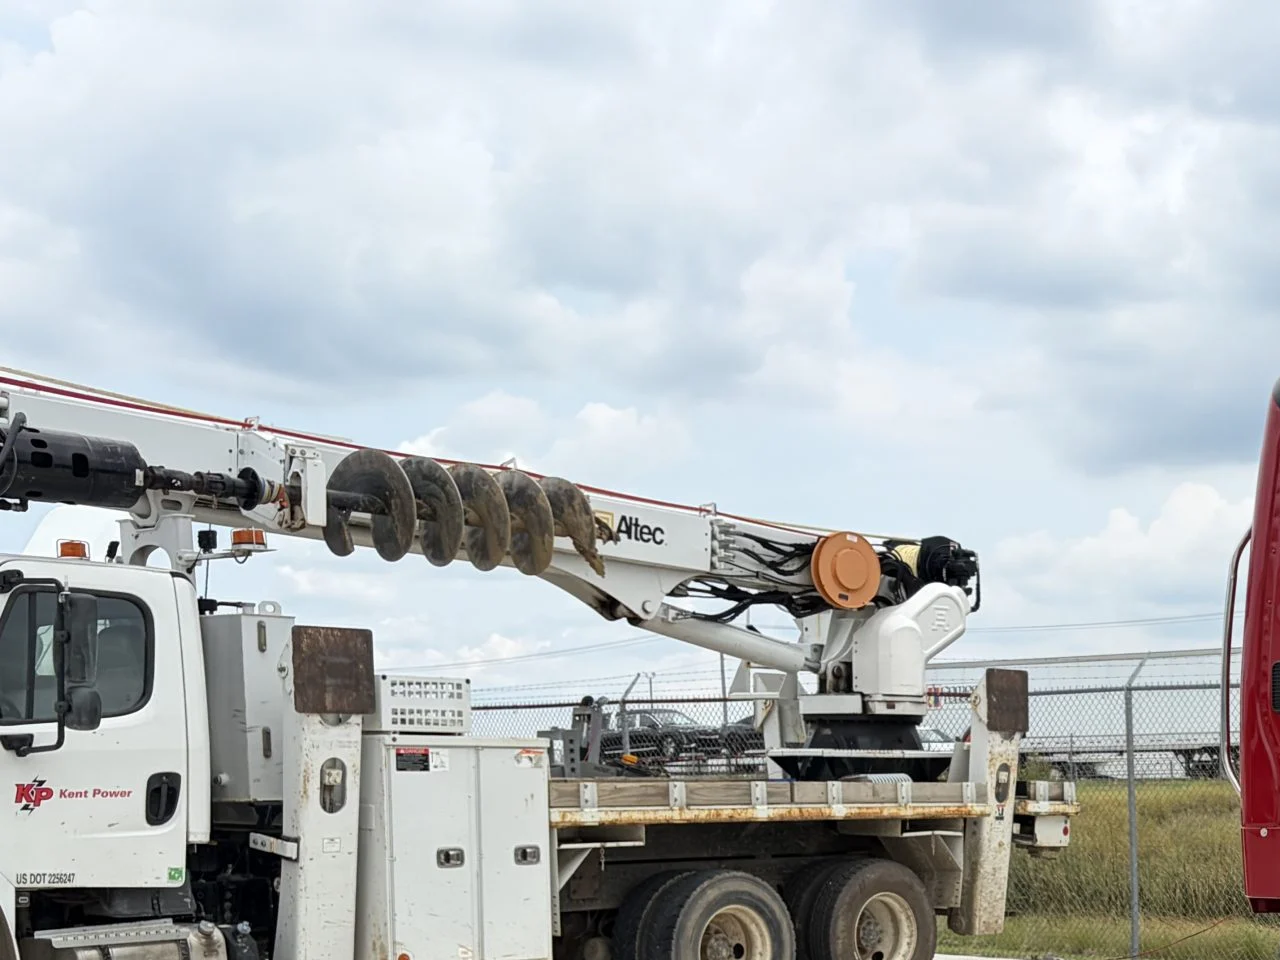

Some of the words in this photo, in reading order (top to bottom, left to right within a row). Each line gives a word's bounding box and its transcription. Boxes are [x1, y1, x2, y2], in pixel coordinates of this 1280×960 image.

[617, 515, 665, 545] Altec
[15, 783, 54, 807] KP
[59, 788, 88, 799] Kent
[92, 788, 133, 799] Power
[16, 873, 28, 885] US
[29, 873, 48, 884] DOT
[48, 873, 76, 884] 2256247
